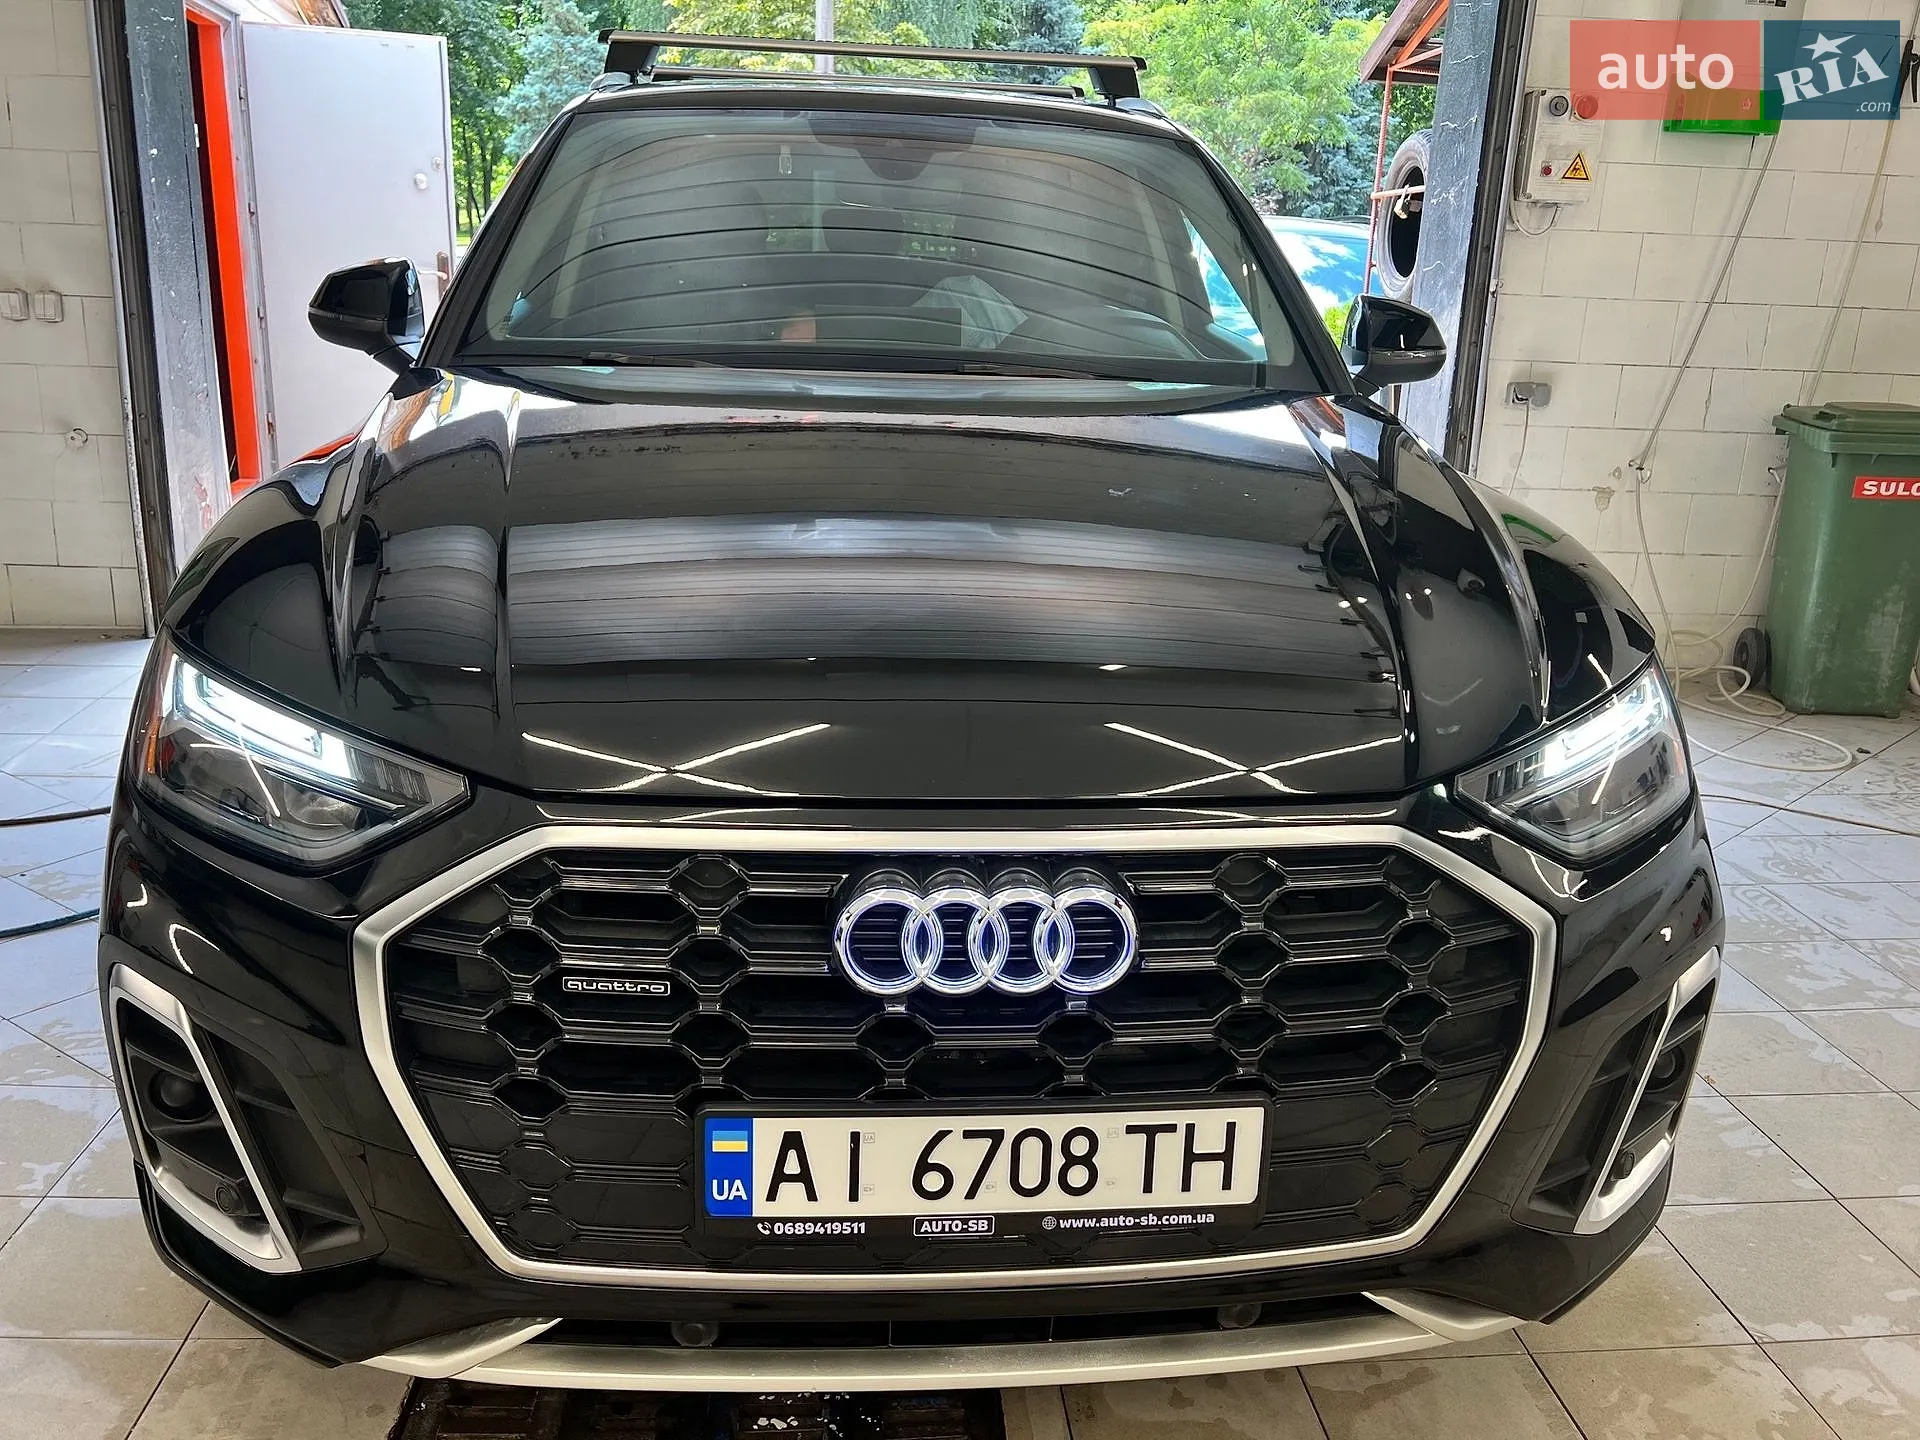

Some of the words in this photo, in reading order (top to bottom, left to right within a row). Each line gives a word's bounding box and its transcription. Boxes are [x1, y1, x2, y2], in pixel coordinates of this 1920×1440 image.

[567, 981, 665, 992] quattro
[765, 1131, 861, 1202] AI
[912, 1127, 1099, 1200] 6708
[1125, 1121, 1237, 1194] TH
[712, 1180, 747, 1200] UA
[774, 1222, 866, 1234] 0689419511
[920, 1219, 988, 1232] AUTO-SB
[1059, 1213, 1215, 1229] www.auto-sb.com.ua
